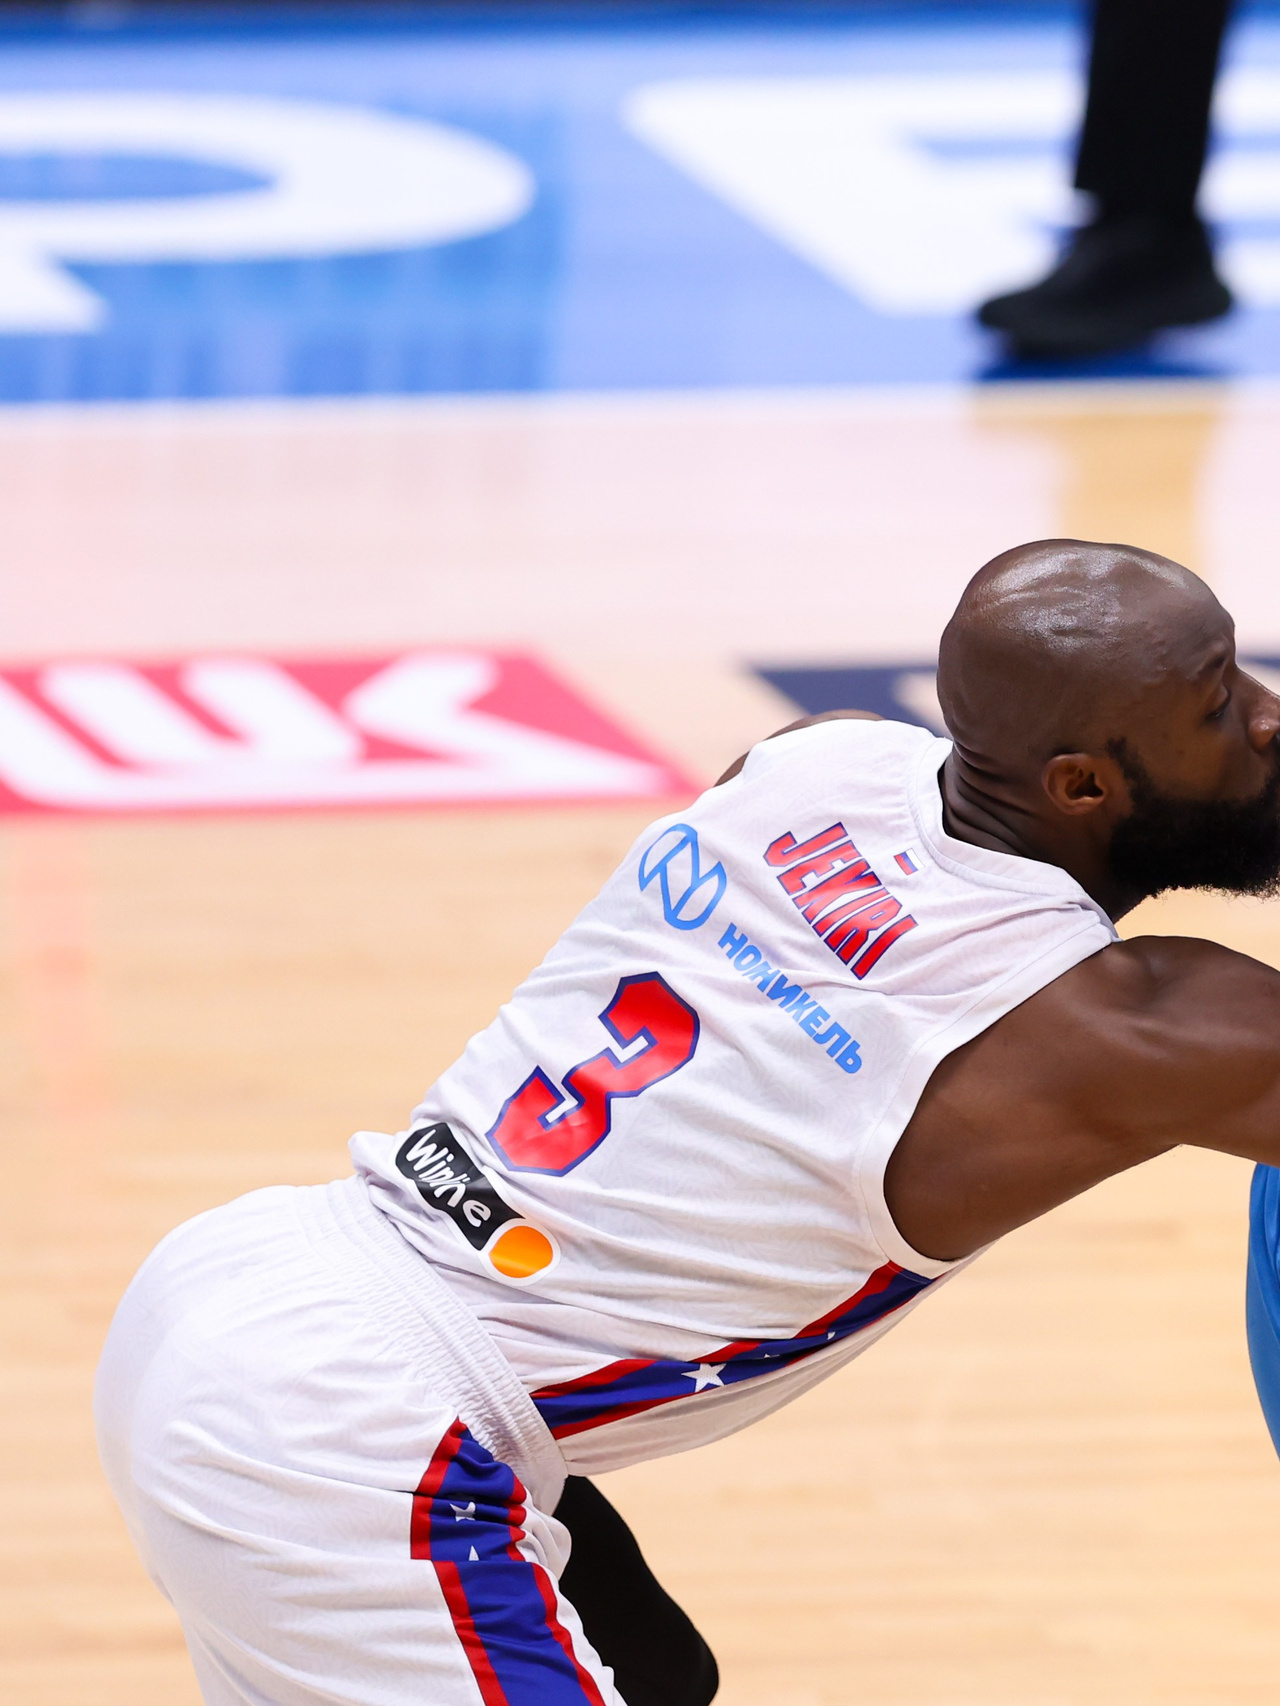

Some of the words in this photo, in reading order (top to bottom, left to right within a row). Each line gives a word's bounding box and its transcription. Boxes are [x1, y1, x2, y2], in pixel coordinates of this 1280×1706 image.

[763, 821, 919, 981] JEKIRI
[486, 972, 700, 1177] 3
[717, 922, 863, 1074] НОНИКЕЛЬ
